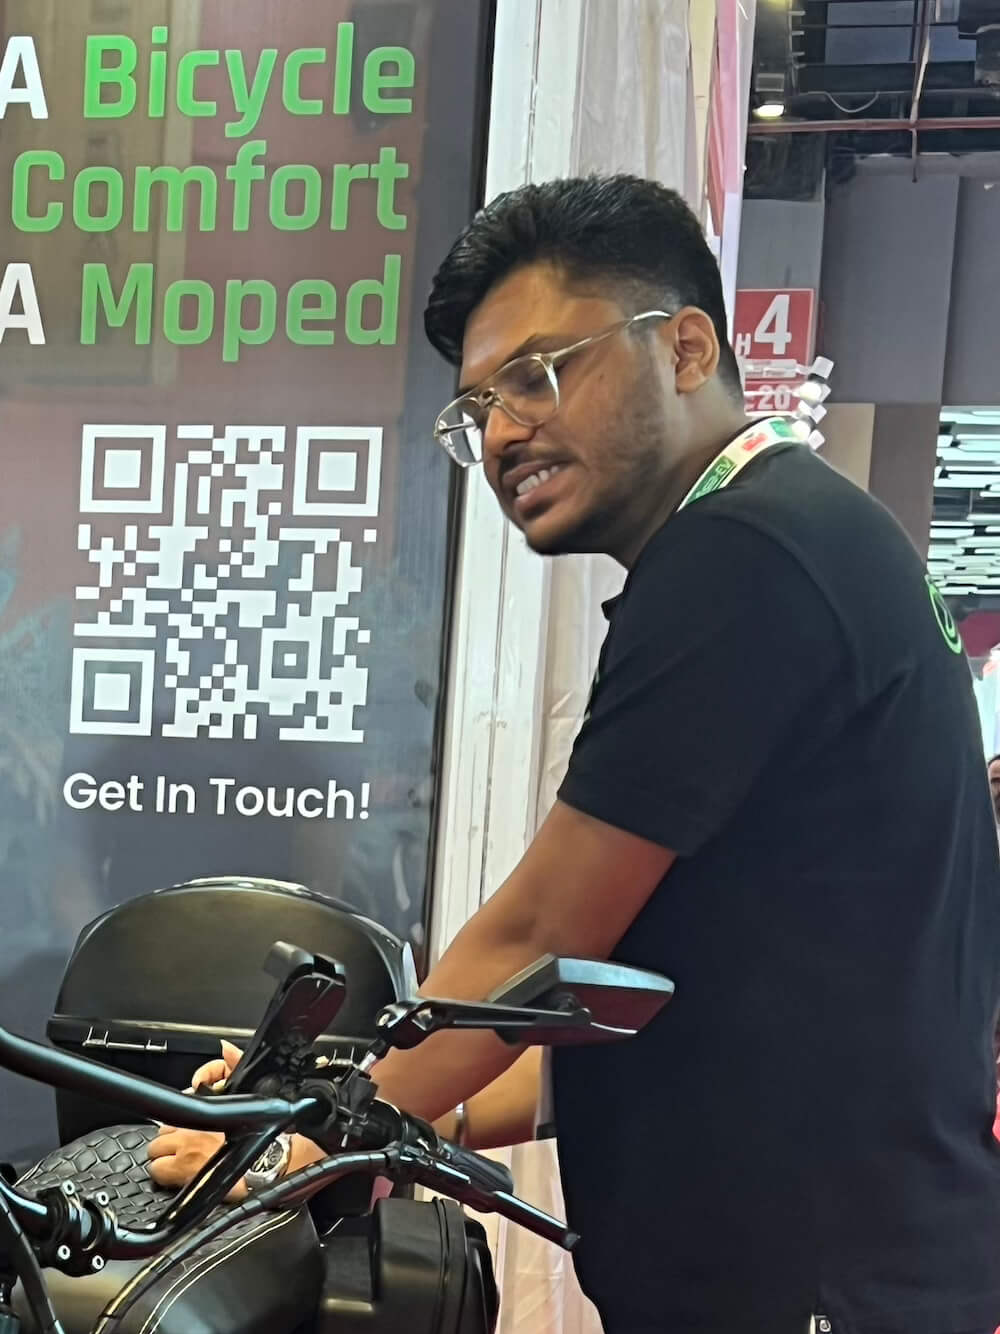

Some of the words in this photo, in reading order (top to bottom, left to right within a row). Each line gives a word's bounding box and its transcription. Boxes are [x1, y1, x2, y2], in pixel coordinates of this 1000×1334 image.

[83, 22, 416, 138] Bicycle
[11, 139, 410, 233] Comfort
[80, 254, 402, 363] Moped
[62, 772, 144, 812] Get
[155, 775, 196, 814] In
[208, 777, 371, 820] Touch!
